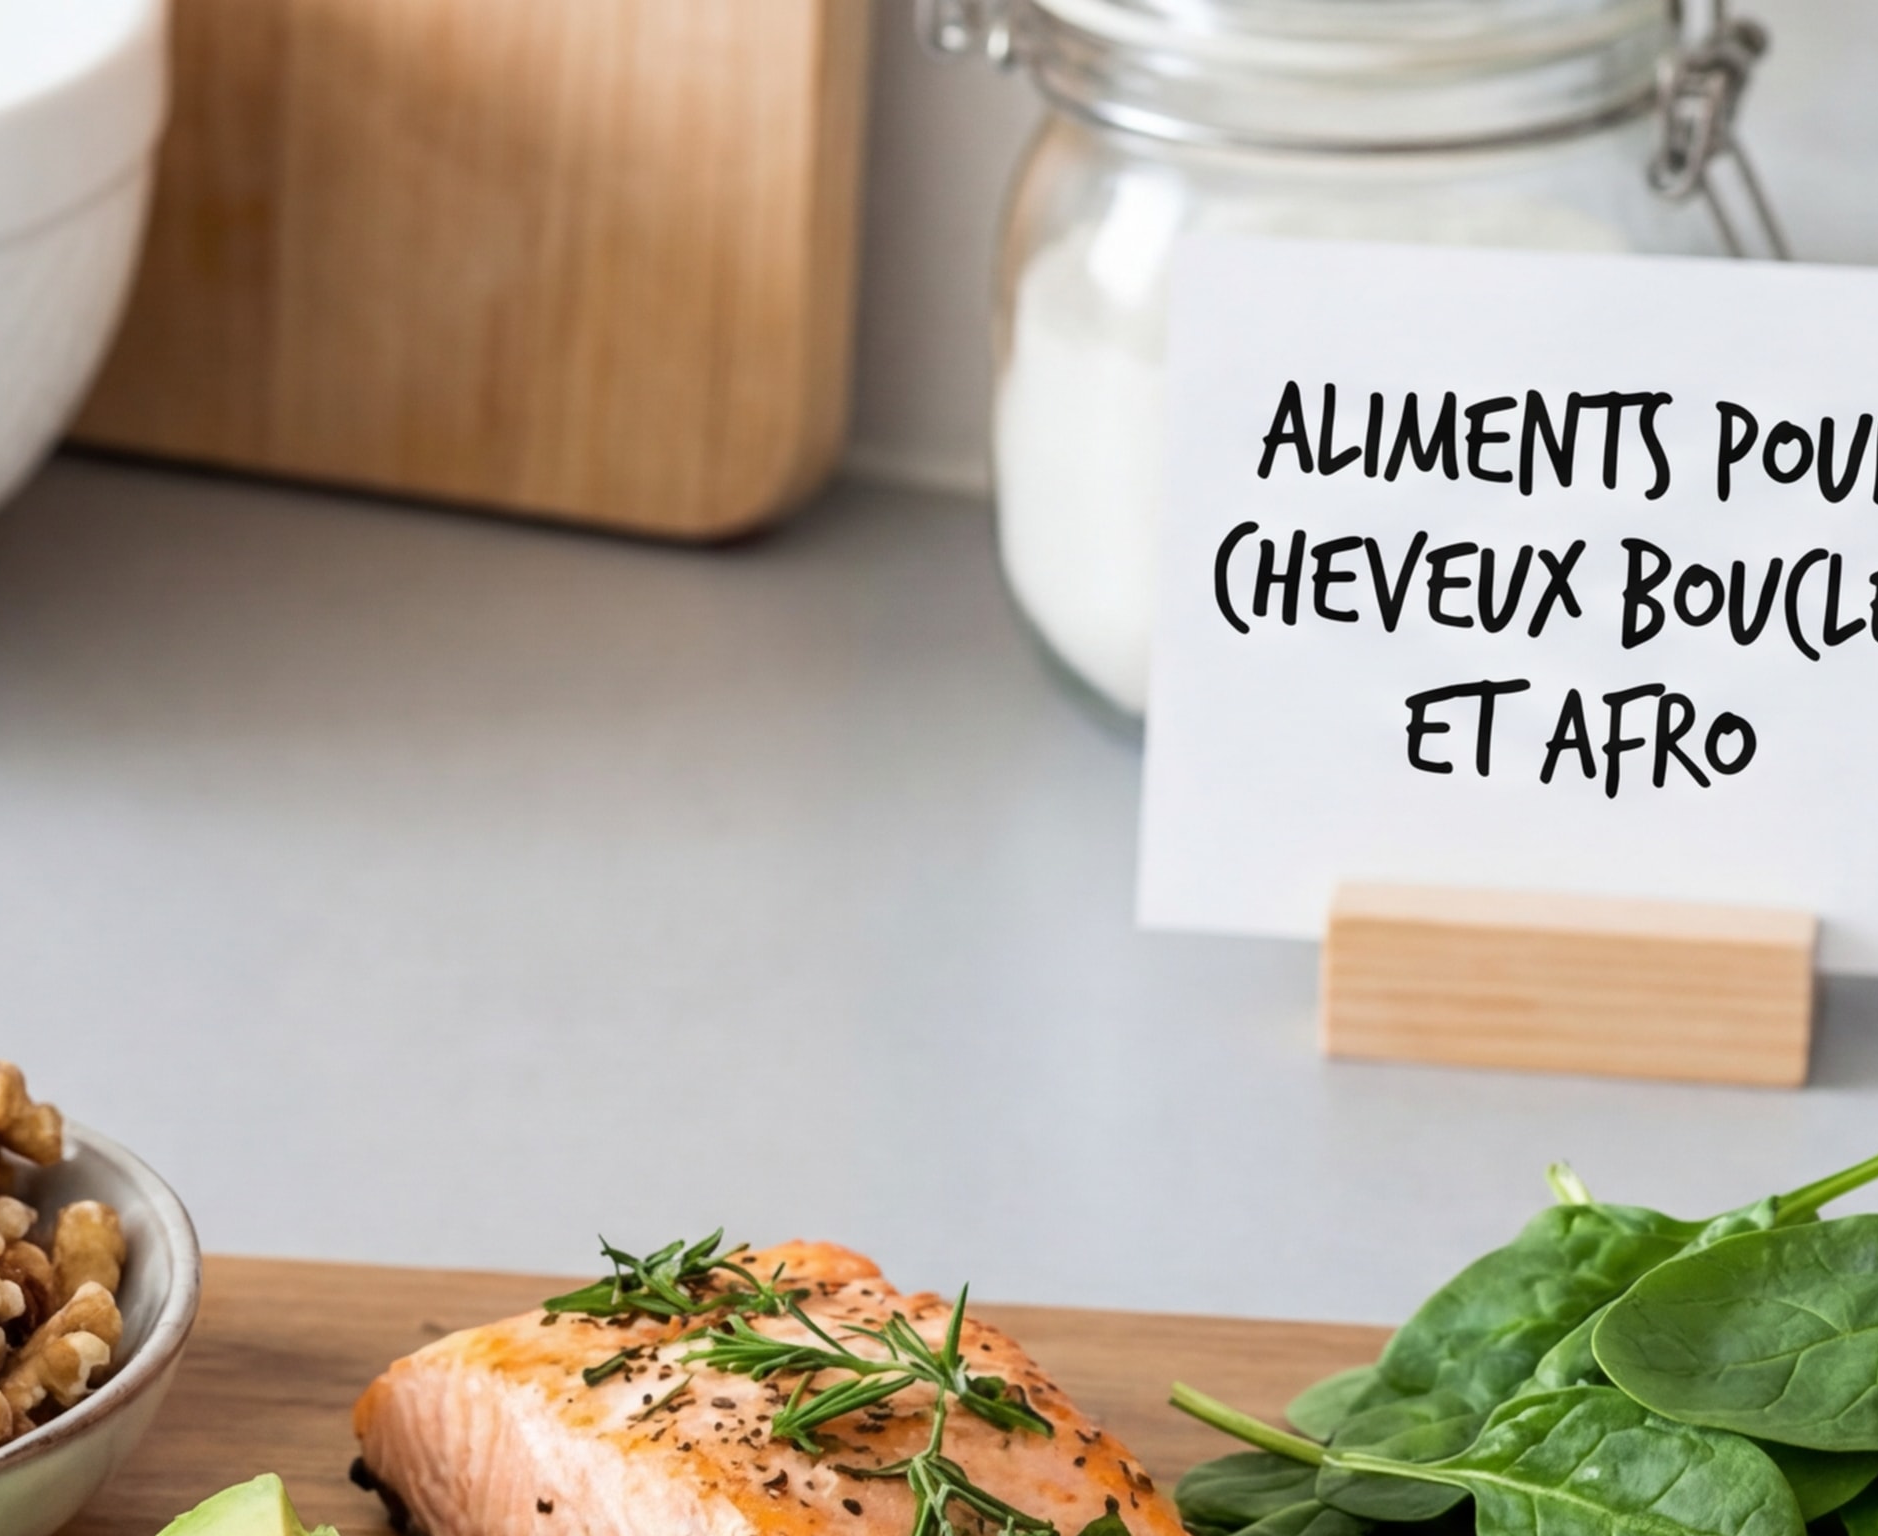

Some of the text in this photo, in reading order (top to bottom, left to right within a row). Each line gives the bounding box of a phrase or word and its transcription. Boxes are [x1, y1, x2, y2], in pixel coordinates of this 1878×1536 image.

[1257, 380, 1673, 501] ALIMENTS
[1214, 521, 1587, 638] CHEVEUX
[1404, 678, 1757, 800] ET AFRO
